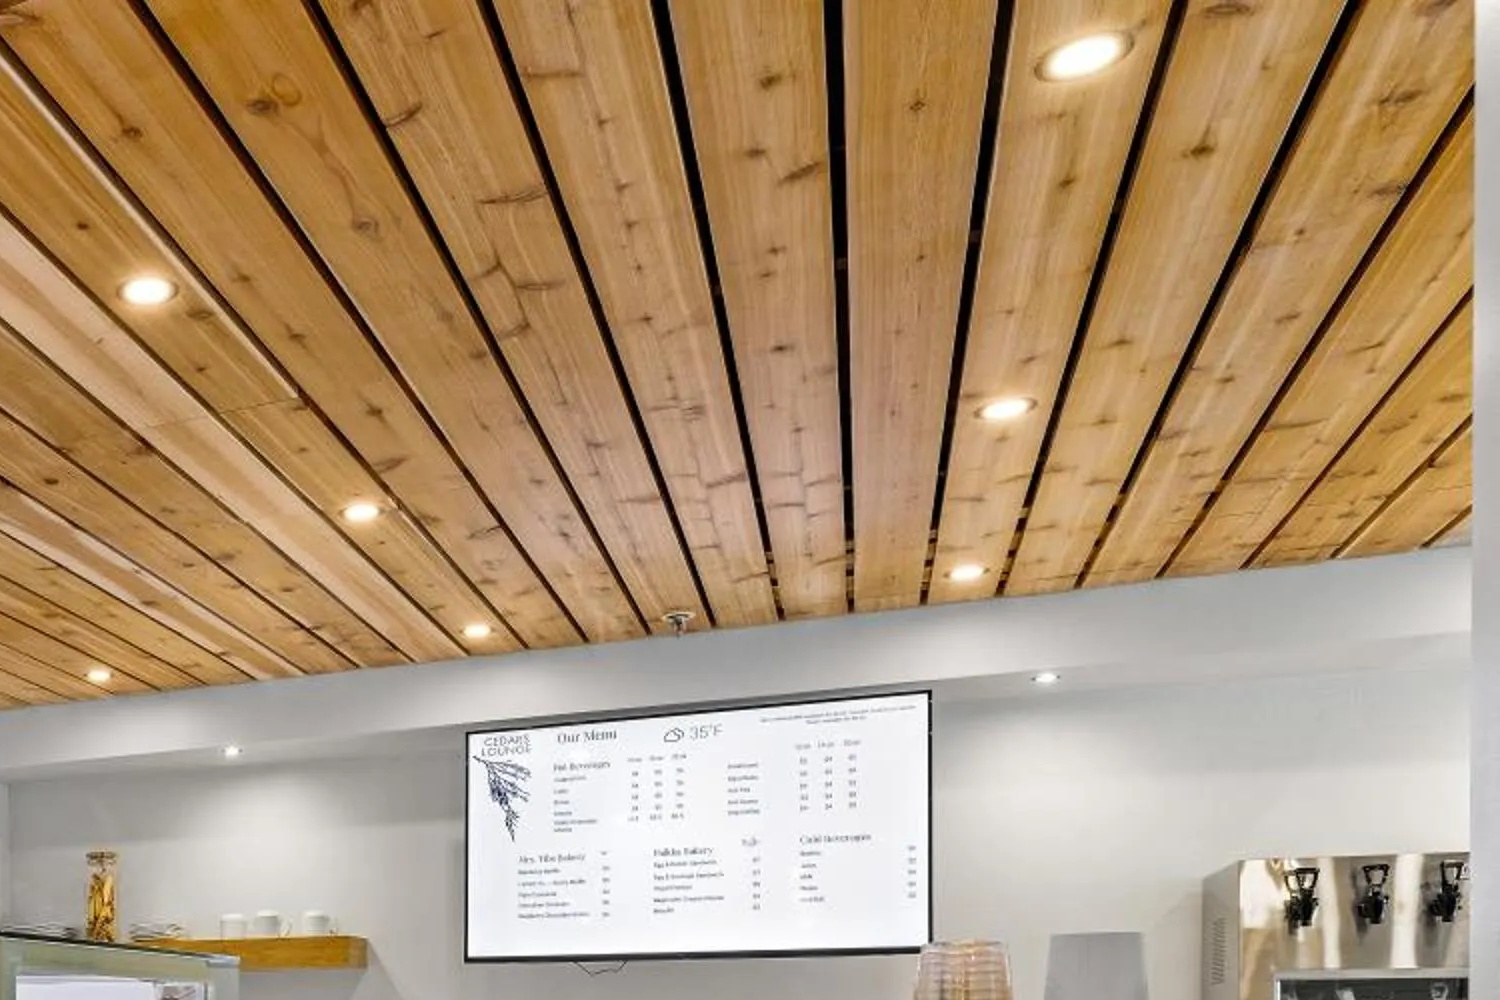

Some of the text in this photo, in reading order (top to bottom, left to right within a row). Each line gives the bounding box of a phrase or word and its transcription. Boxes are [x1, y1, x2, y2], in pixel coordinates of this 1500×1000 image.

[483, 734, 531, 747] CEDARS
[557, 728, 618, 745] Our Menu
[481, 745, 532, 757] LOUNGE
